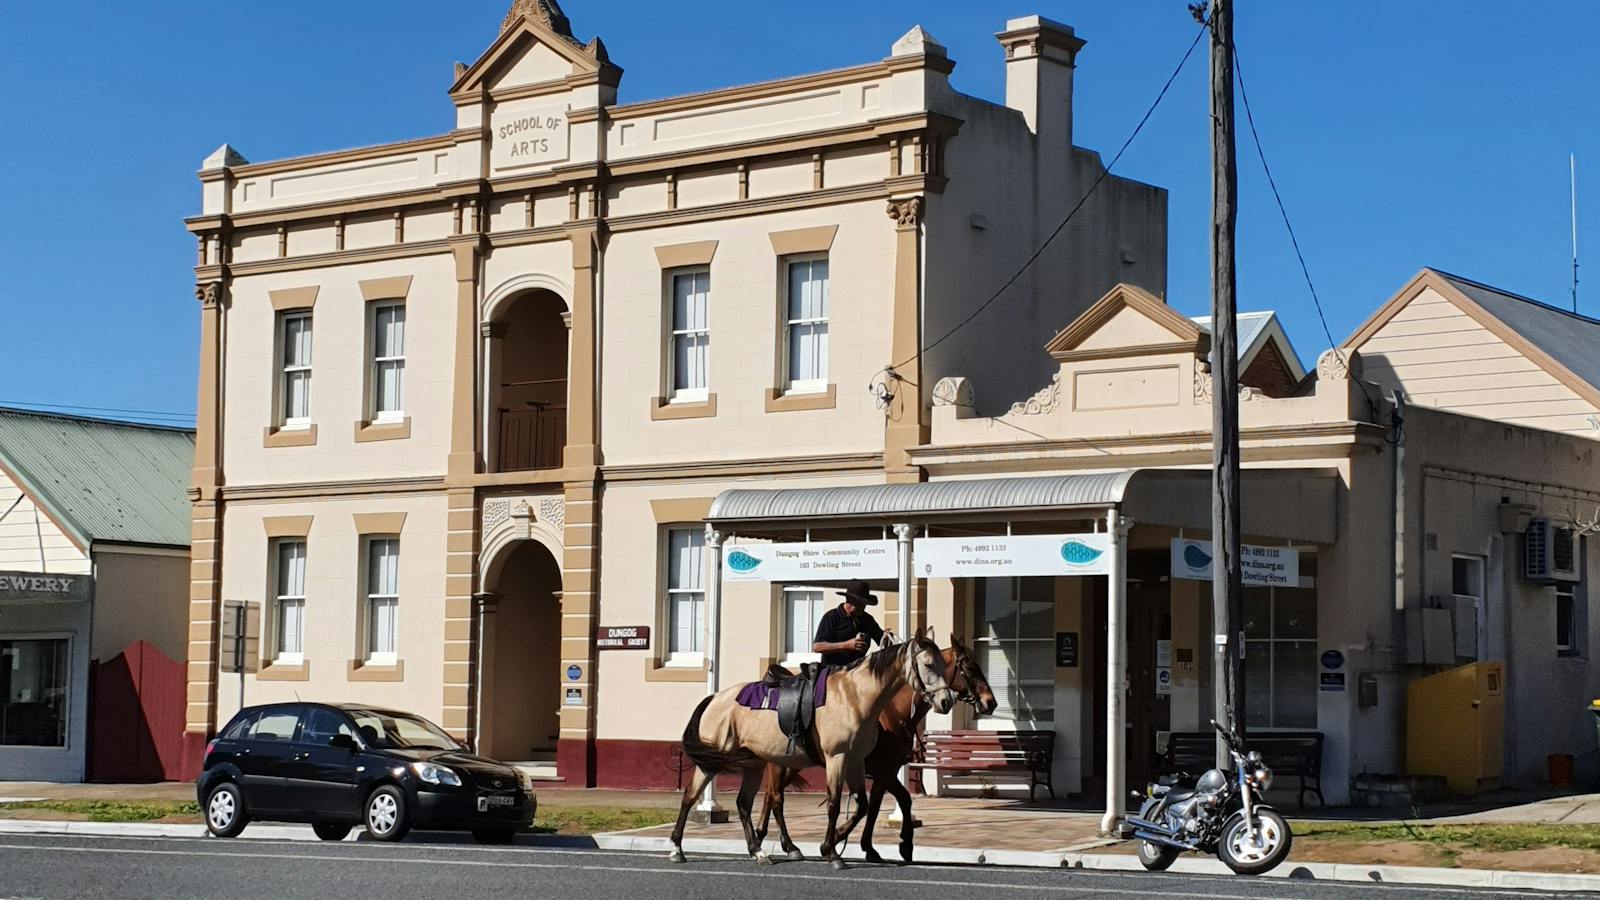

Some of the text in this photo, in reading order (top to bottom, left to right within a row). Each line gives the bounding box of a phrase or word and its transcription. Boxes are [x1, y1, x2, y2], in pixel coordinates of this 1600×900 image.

[499, 116, 562, 139] SCHOOL OF
[511, 138, 548, 157] ARTS
[775, 550, 800, 558] Dungog
[823, 548, 860, 557] Community
[863, 547, 886, 555] Centre
[813, 561, 839, 569] Dowling
[841, 560, 862, 568] Street
[1244, 571, 1268, 583] Dowling
[1269, 573, 1287, 583] Street
[0, 575, 74, 593] EWERY
[608, 628, 637, 638] DUNGOG
